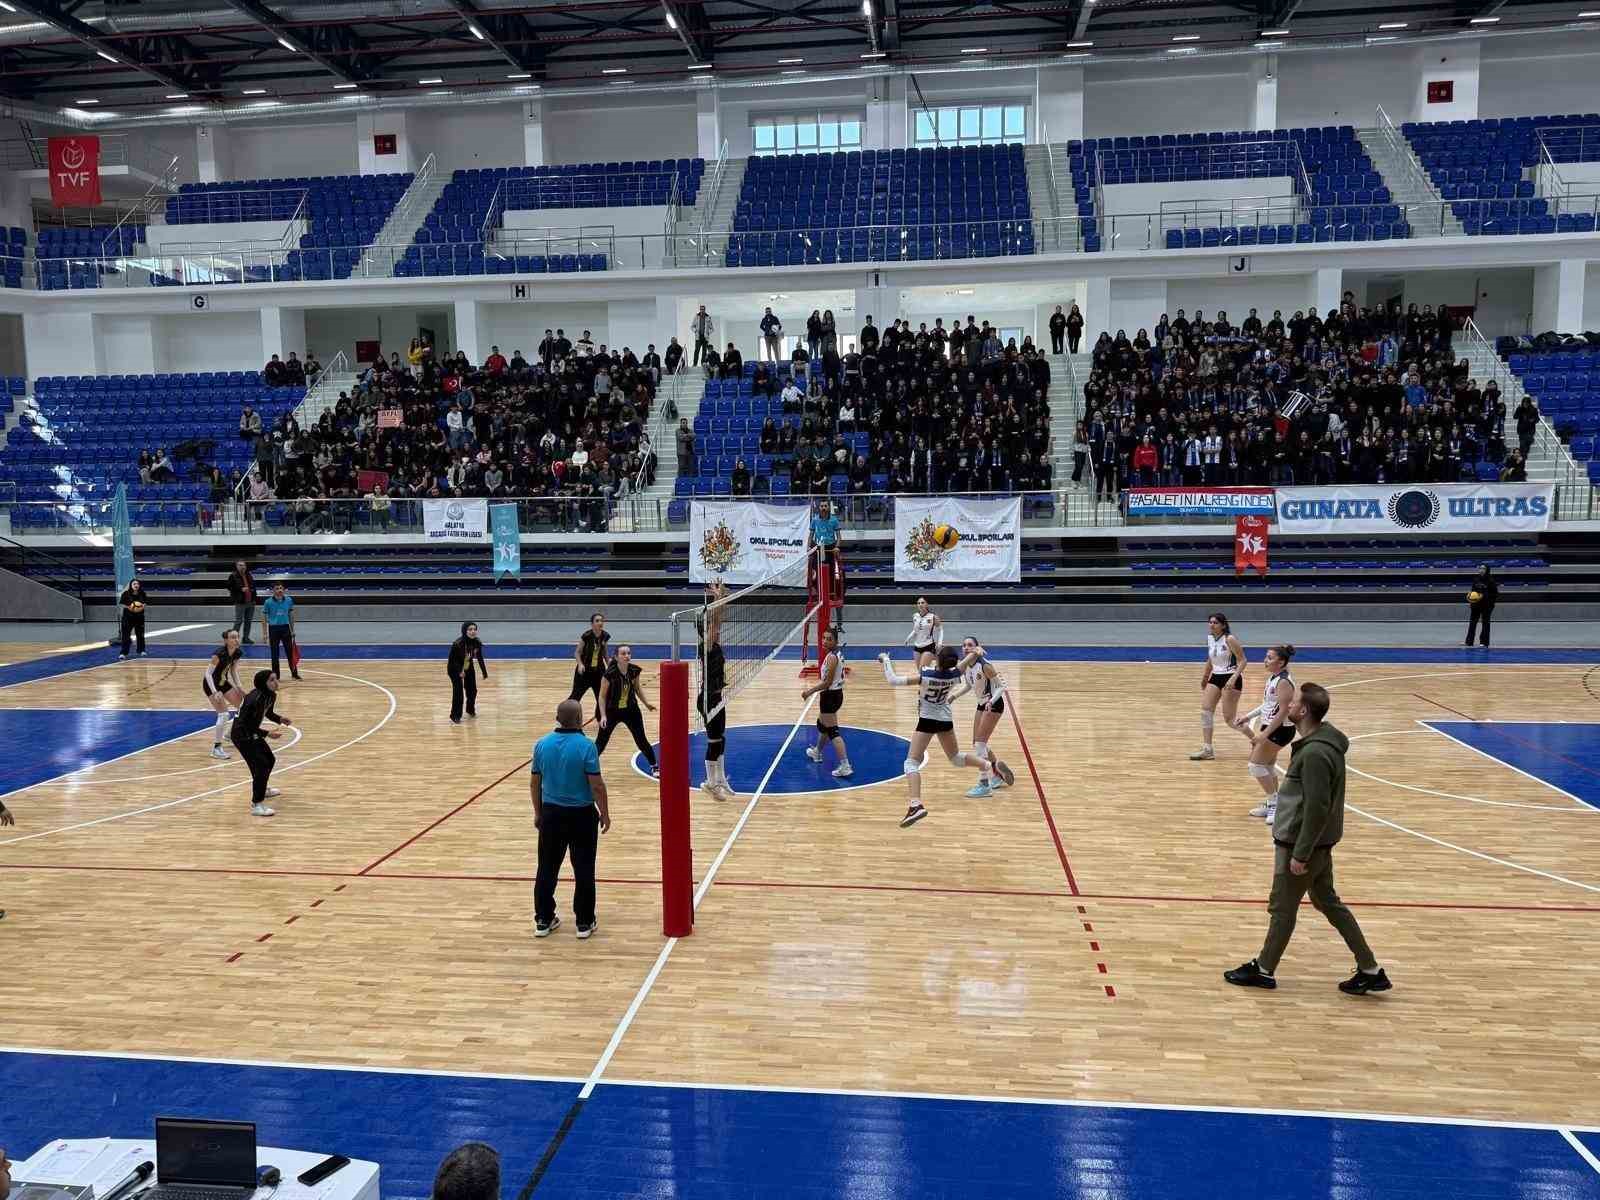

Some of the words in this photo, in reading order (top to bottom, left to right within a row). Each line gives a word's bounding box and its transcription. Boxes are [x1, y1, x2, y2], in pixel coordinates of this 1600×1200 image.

[57, 172, 90, 188] TVF
[1234, 257, 1245, 271] J
[515, 285, 526, 298] H
[194, 295, 205, 308] G
[1448, 496, 1548, 518] ULTRAS
